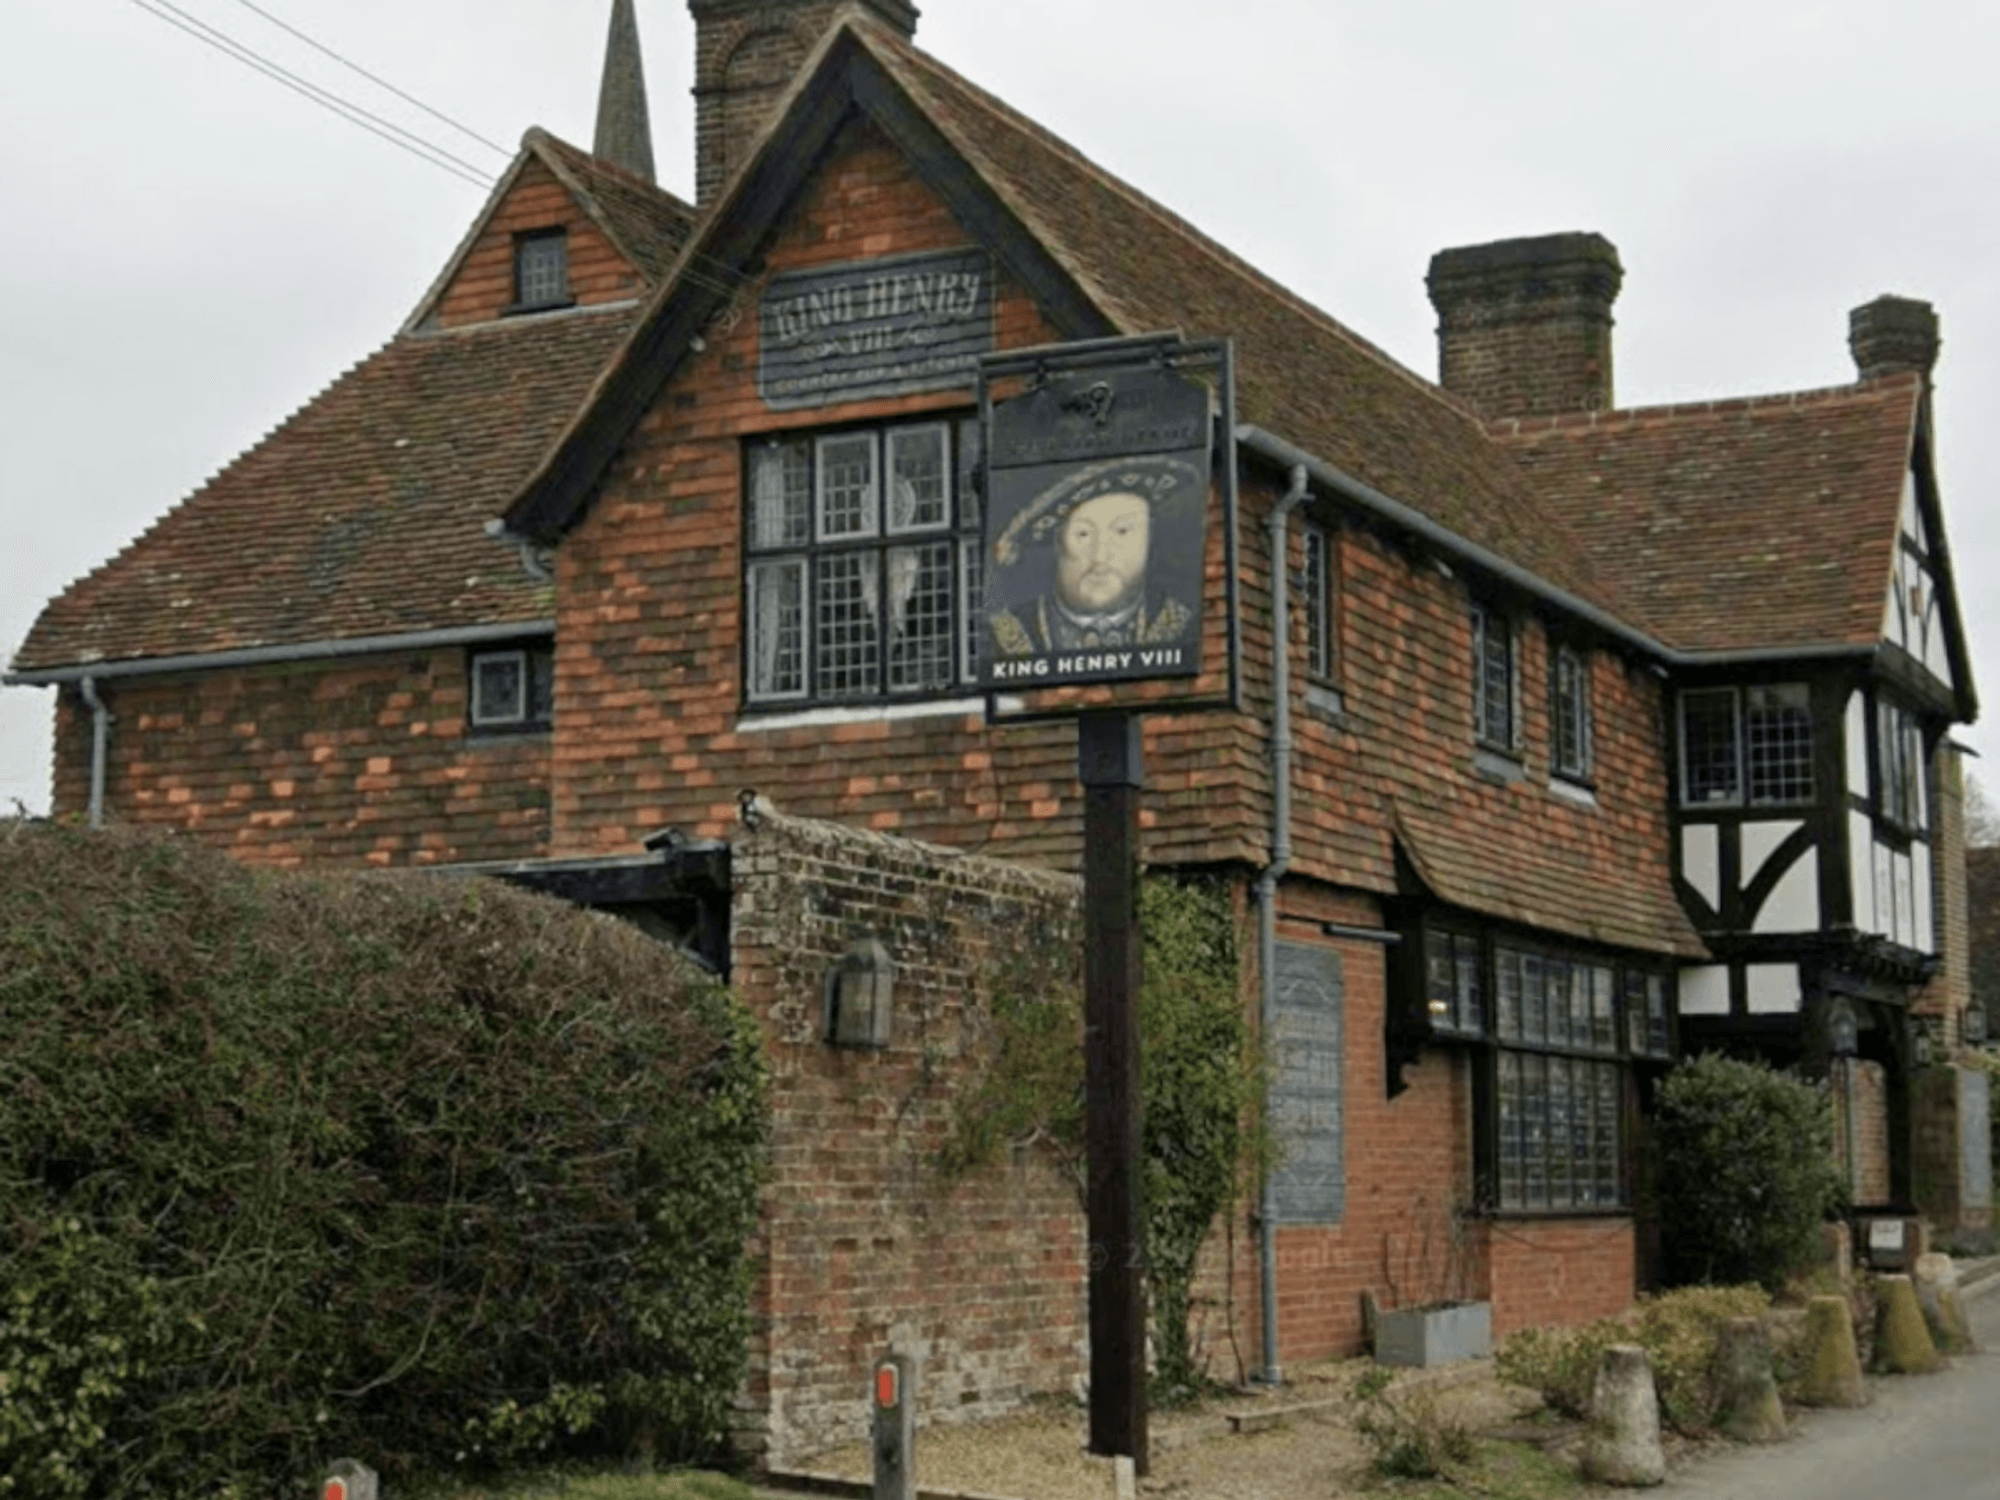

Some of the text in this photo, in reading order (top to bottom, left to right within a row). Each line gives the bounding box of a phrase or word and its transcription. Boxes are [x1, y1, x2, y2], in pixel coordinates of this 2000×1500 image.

[773, 272, 981, 340] KING HENRY
[993, 649, 1182, 678] KING HENRY VIII
